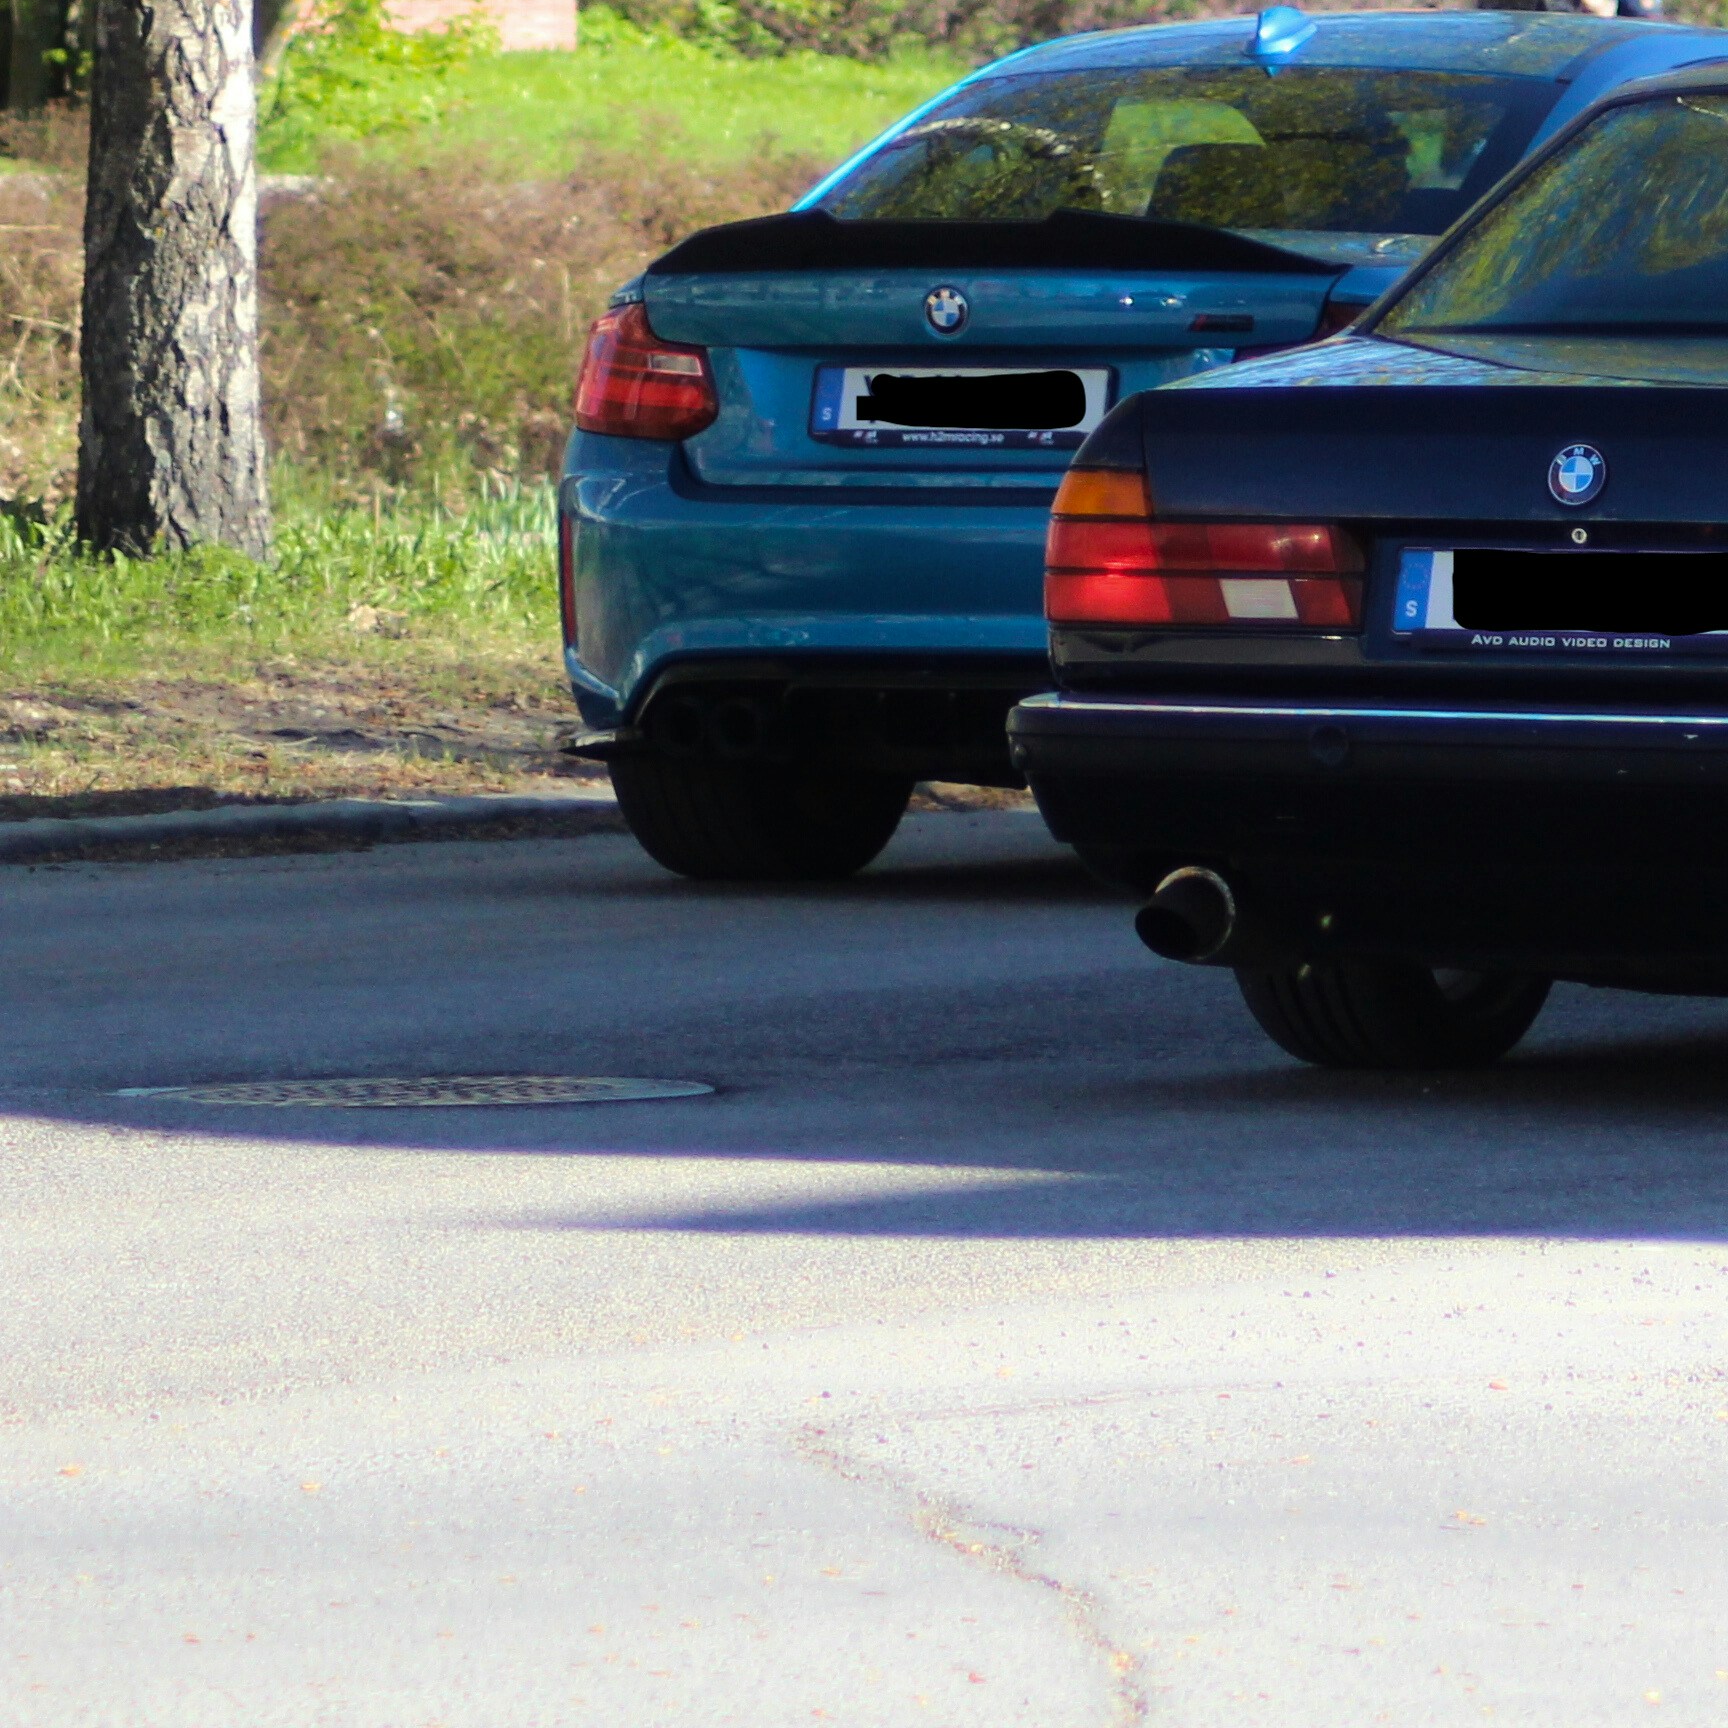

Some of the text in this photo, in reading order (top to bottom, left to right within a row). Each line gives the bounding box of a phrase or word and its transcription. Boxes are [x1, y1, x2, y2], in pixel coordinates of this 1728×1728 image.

[822, 407, 832, 421] S
[1555, 446, 1602, 466] BMW
[1405, 599, 1419, 618] S
[1508, 636, 1556, 647] AUDIO
[1562, 637, 1608, 648] VIDEO
[1613, 638, 1671, 649] DESIGN
